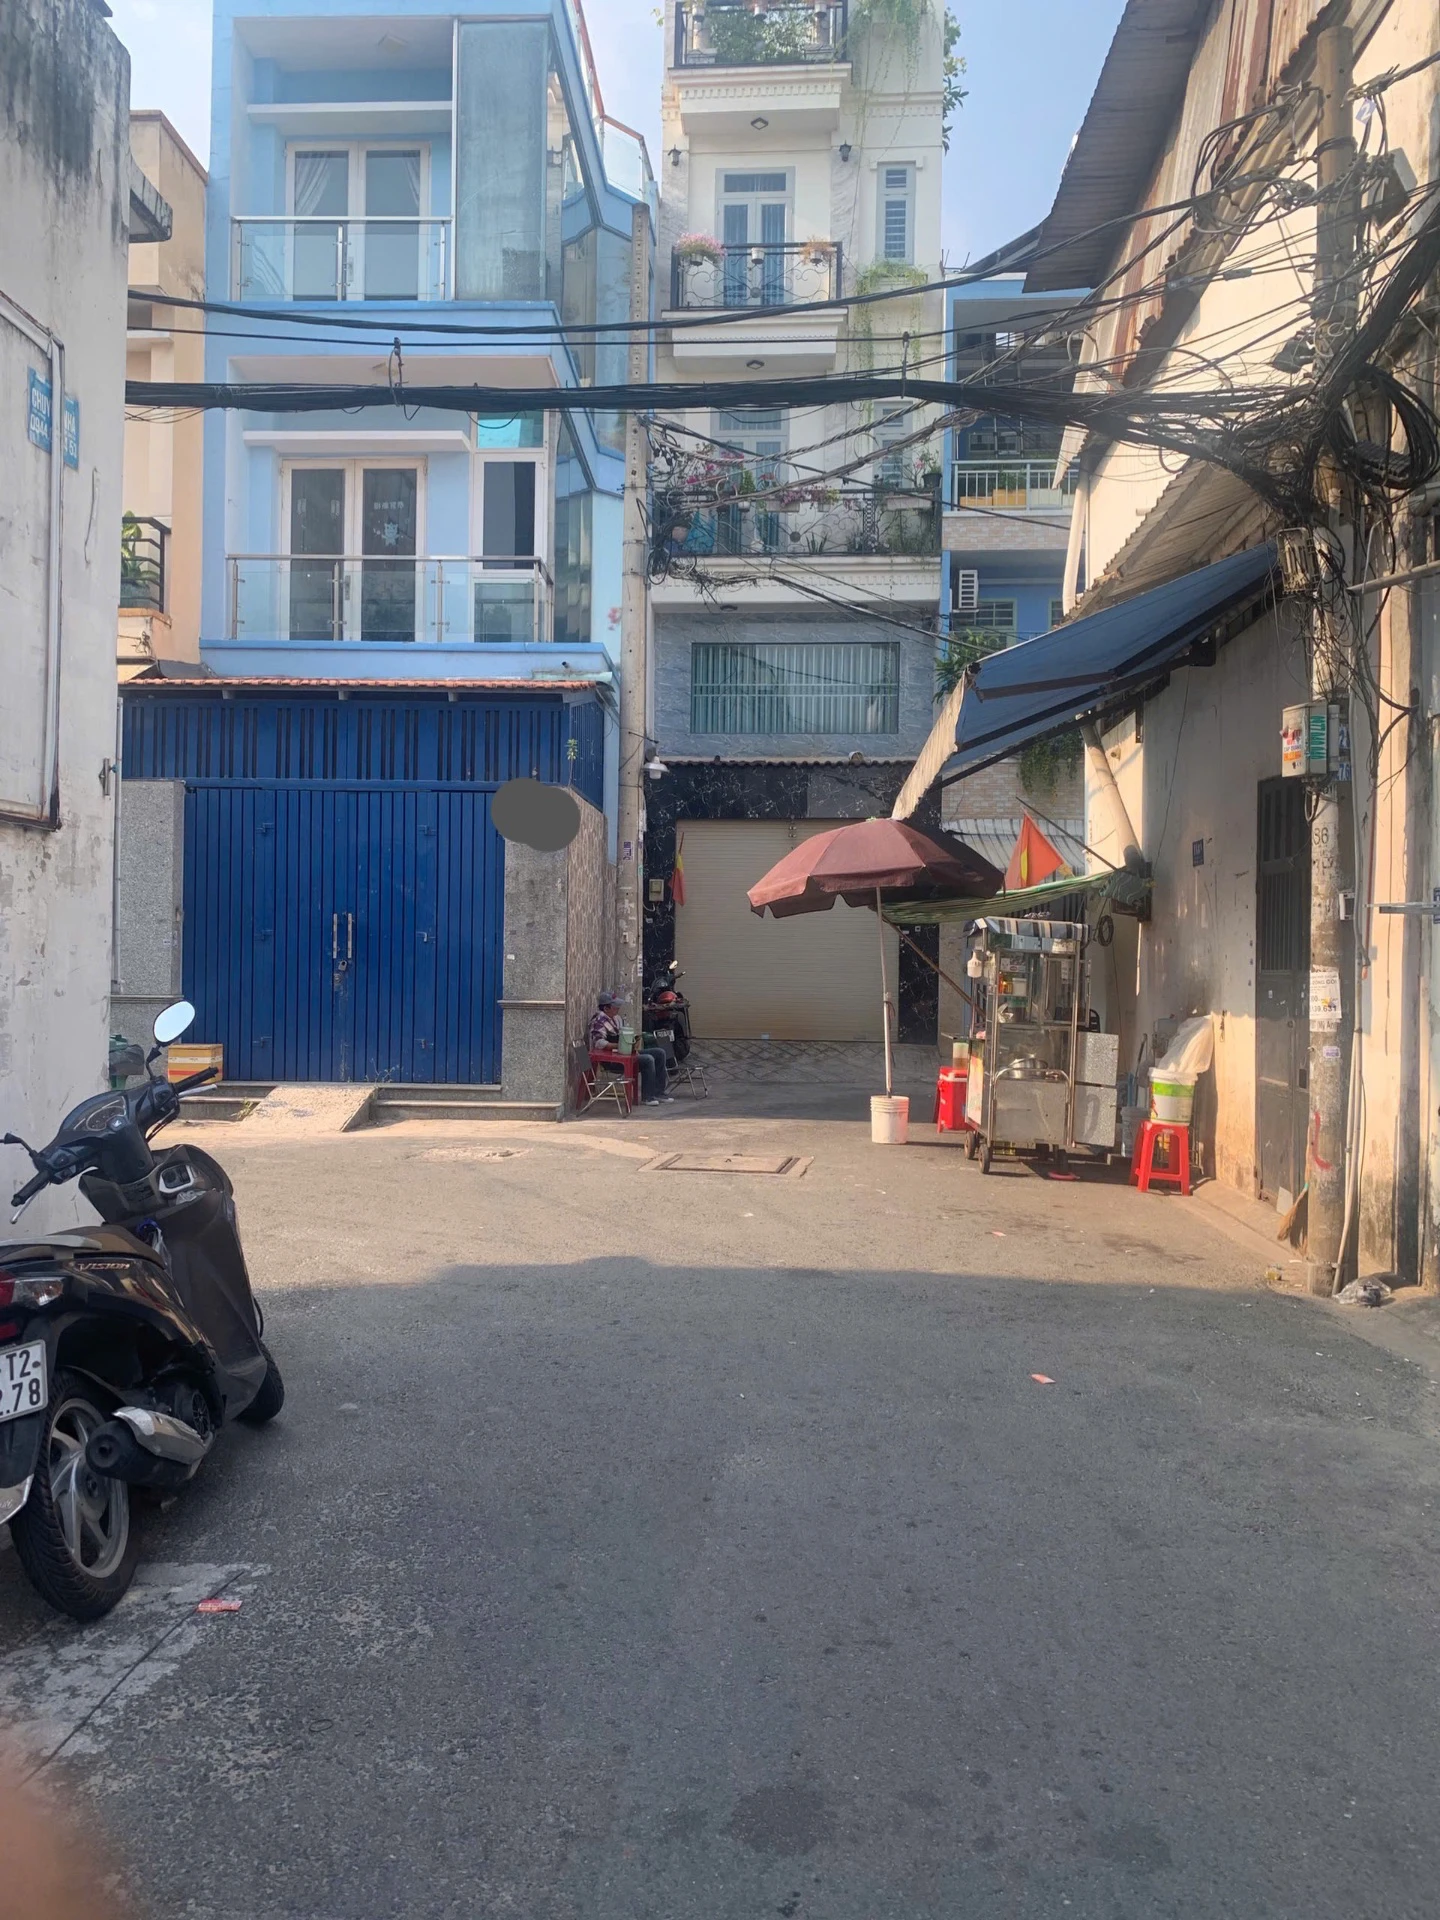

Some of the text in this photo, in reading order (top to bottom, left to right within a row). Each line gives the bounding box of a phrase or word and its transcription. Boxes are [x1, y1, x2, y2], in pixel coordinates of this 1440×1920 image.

[31, 387, 50, 418] CHUY
[78, 1262, 130, 1271] VISION
[0, 1349, 31, 1381] T2
